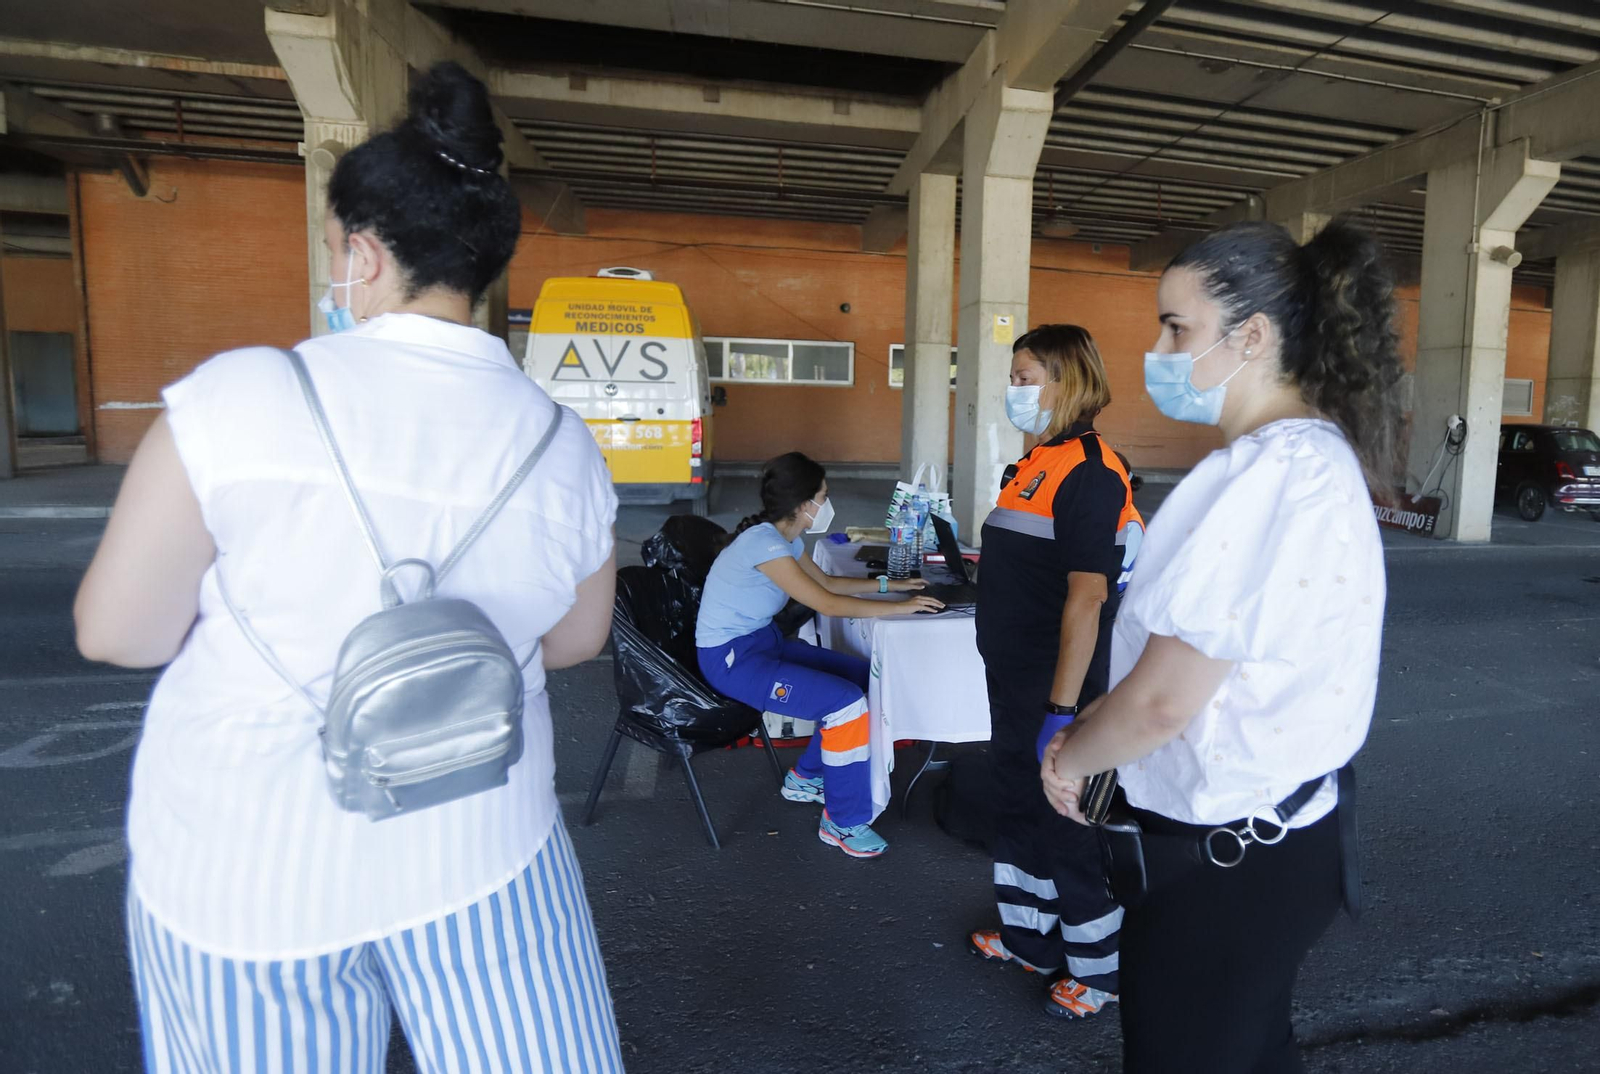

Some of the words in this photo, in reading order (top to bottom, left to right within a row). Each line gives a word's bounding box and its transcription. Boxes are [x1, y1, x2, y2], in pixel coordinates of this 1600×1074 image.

[568, 303, 604, 311] UNIDAD
[607, 304, 637, 312] MOVIL
[564, 312, 656, 322] RECONOCIMIENTOS
[575, 321, 645, 334] MEDICOS
[551, 339, 669, 381] AVS
[635, 425, 663, 439] 568
[1373, 505, 1425, 530] uzcampo
[1425, 515, 1435, 532] SIN
